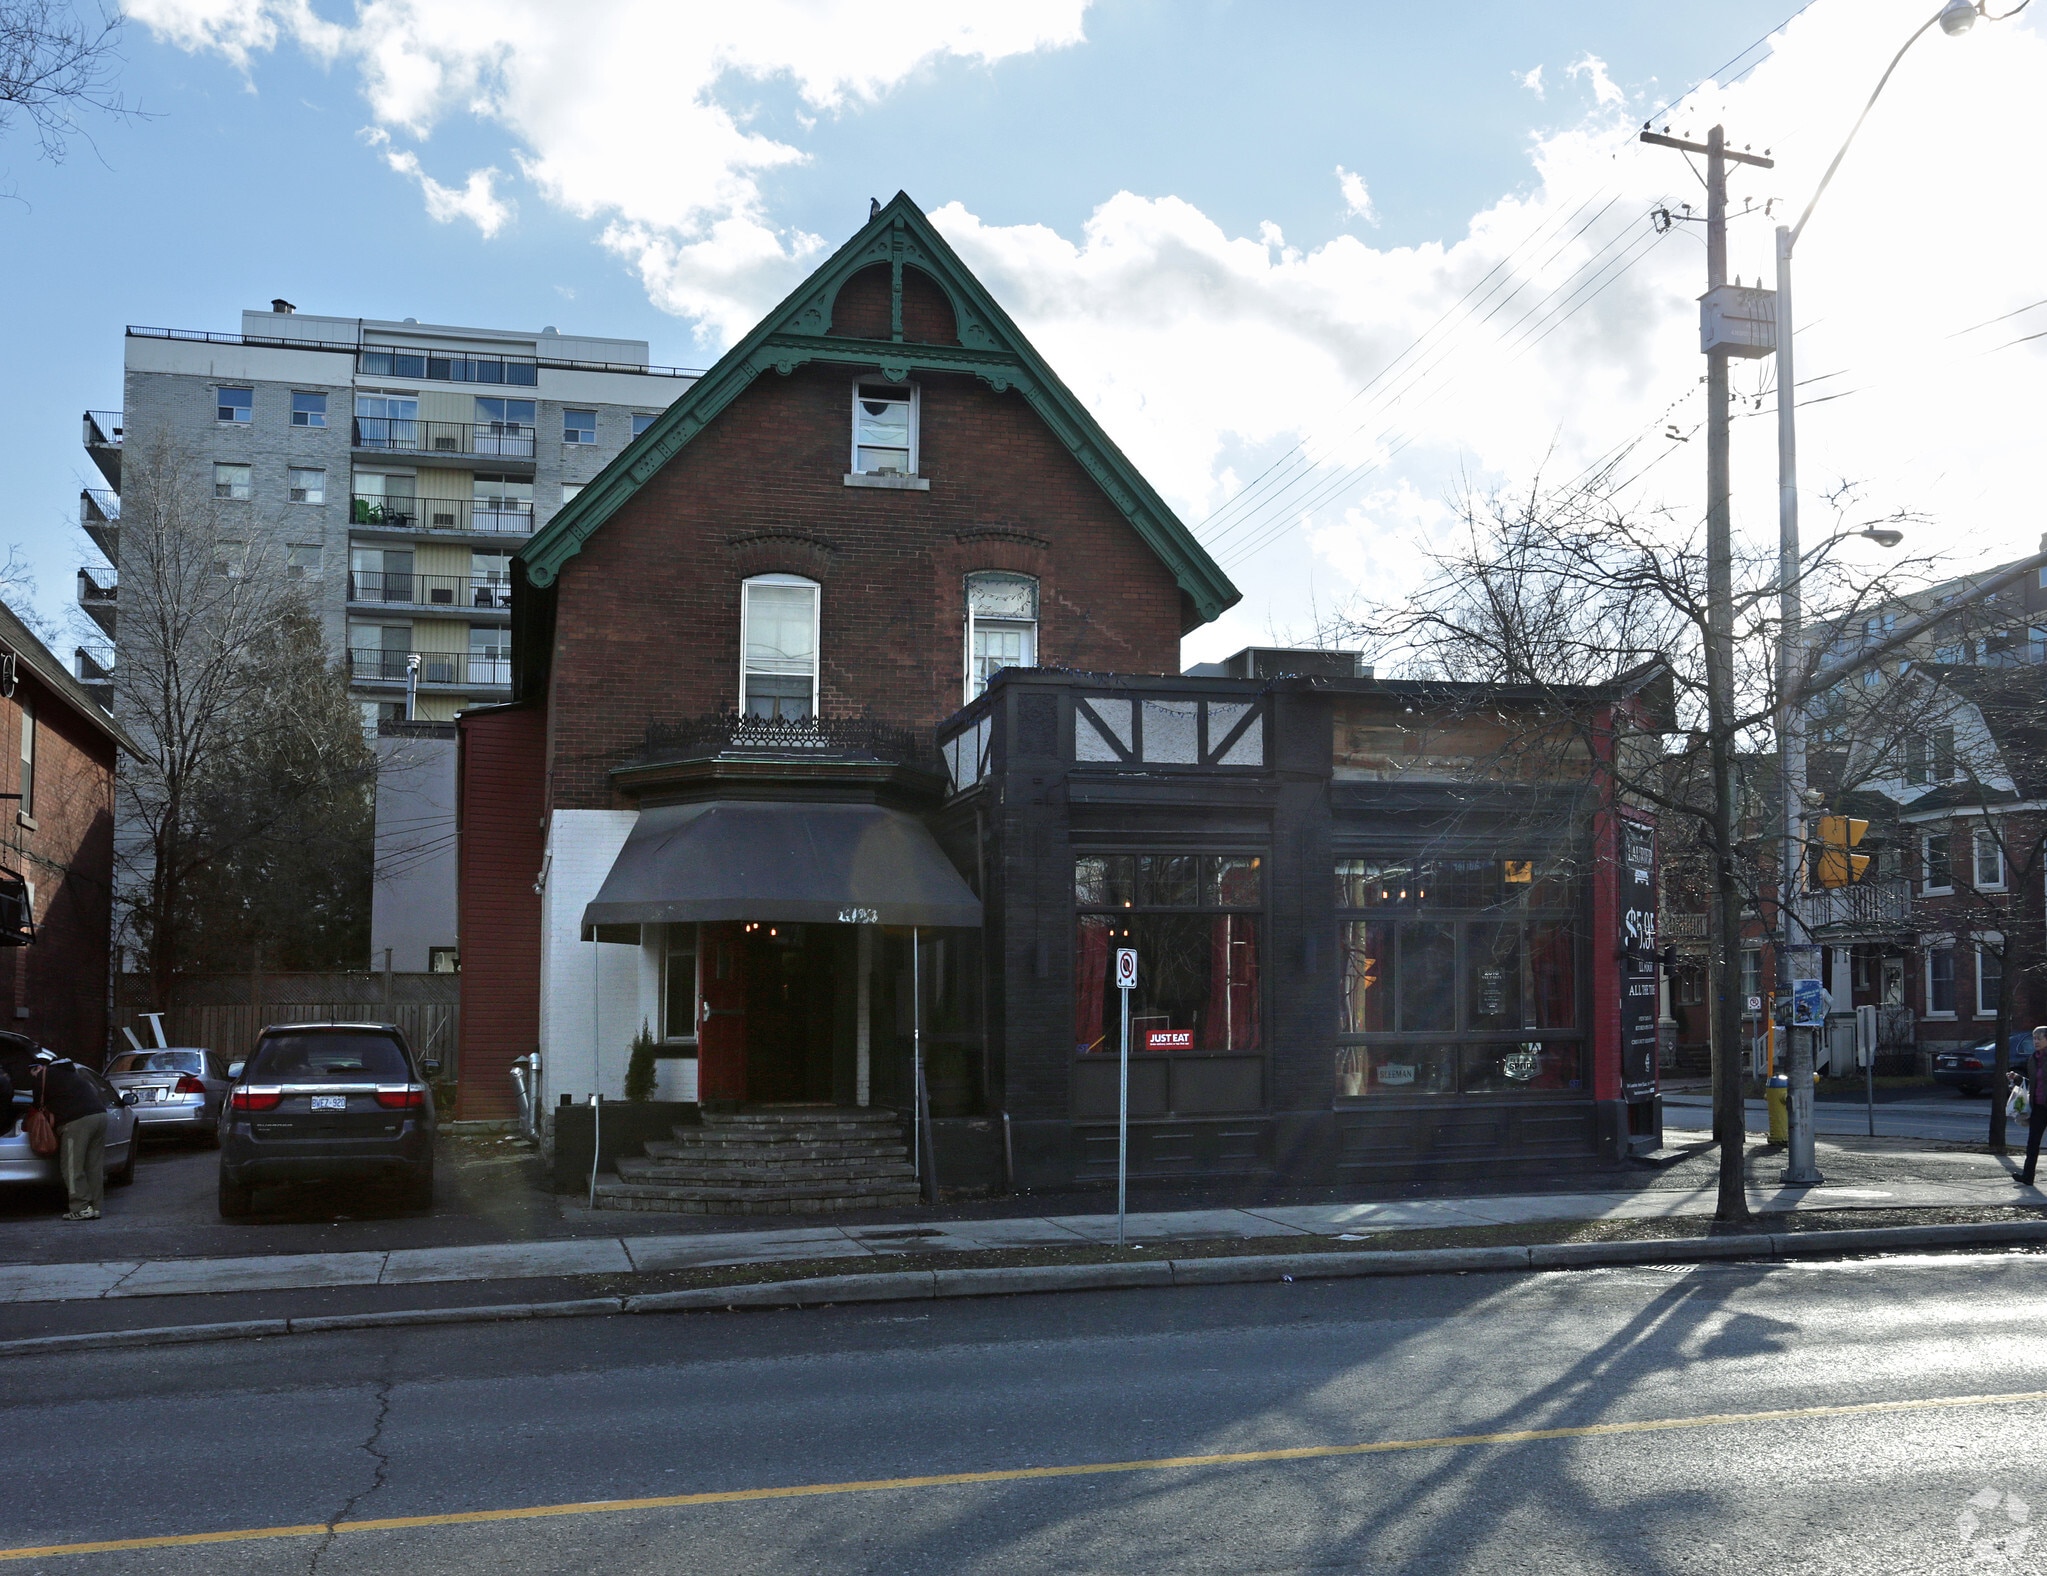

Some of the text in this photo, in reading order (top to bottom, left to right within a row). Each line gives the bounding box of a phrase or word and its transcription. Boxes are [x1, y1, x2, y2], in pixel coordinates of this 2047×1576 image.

[1150, 1033, 1189, 1042] JUST EAT
[1379, 1069, 1412, 1079] SLEEMAN
